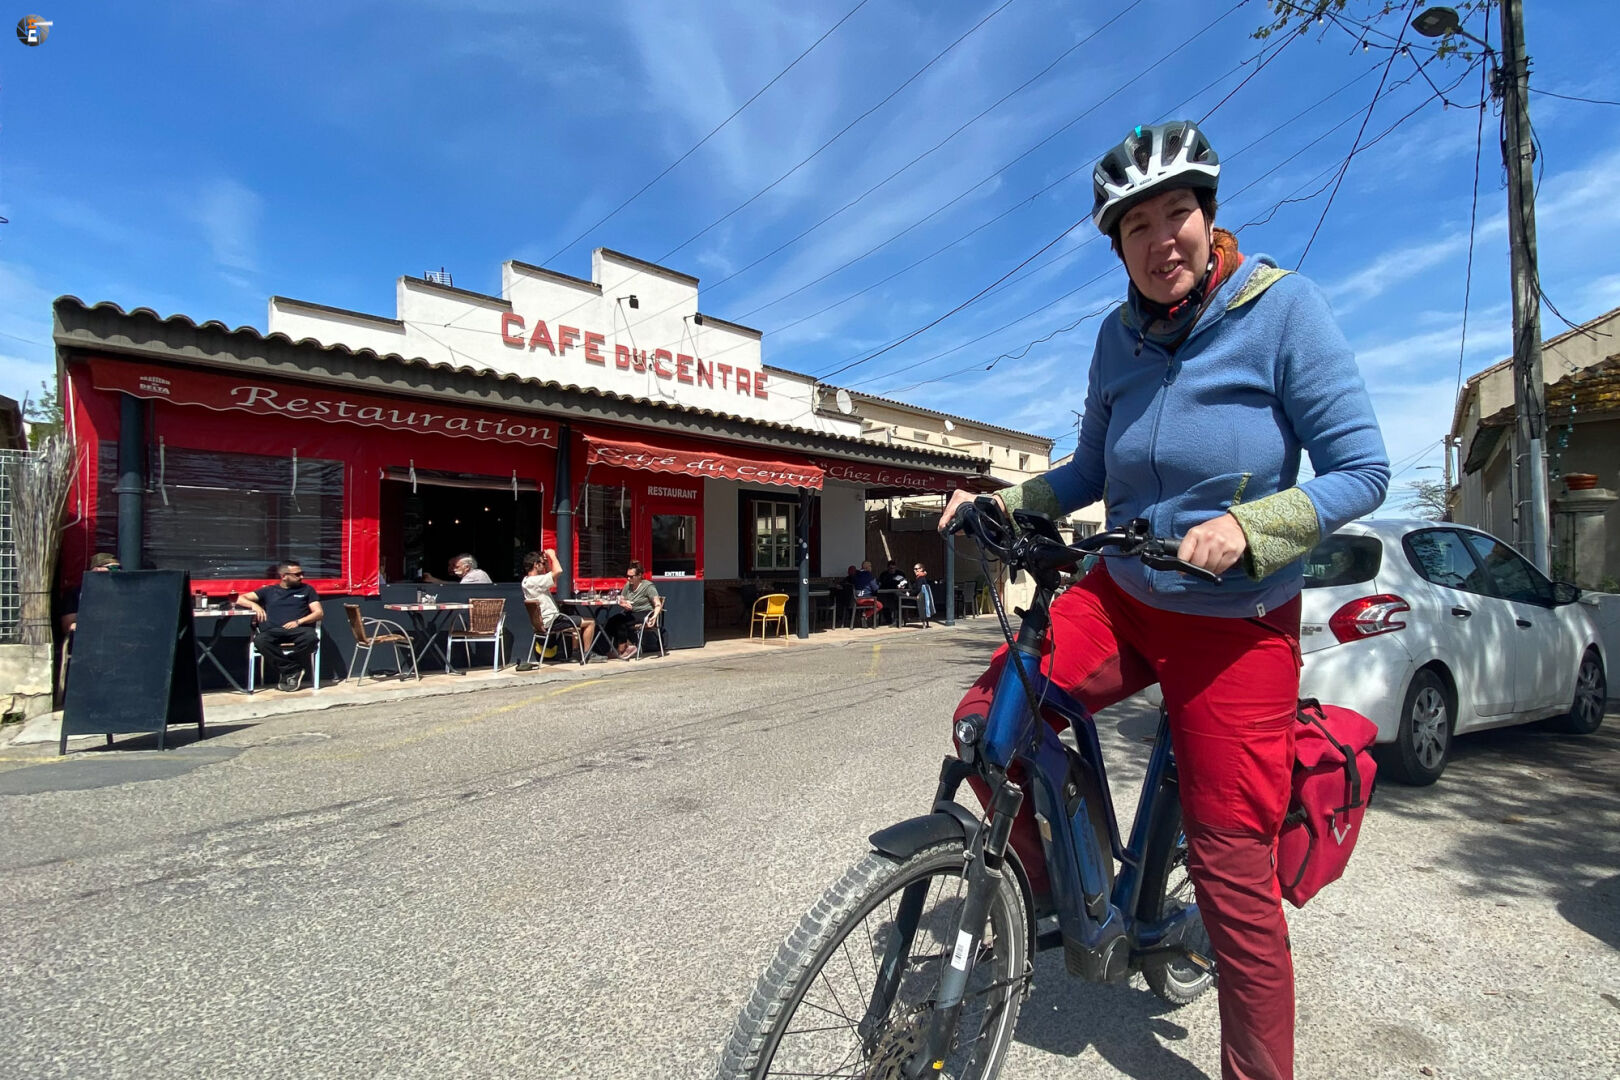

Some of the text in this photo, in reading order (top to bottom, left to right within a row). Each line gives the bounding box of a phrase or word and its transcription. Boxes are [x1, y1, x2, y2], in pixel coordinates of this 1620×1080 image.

[501, 311, 606, 366] CAFE
[654, 347, 769, 398] CENTRE
[230, 386, 553, 440] Restauration
[686, 459, 725, 471] du
[736, 466, 819, 483] Centre
[877, 471, 890, 482] le
[647, 485, 698, 499] RESTAURANT
